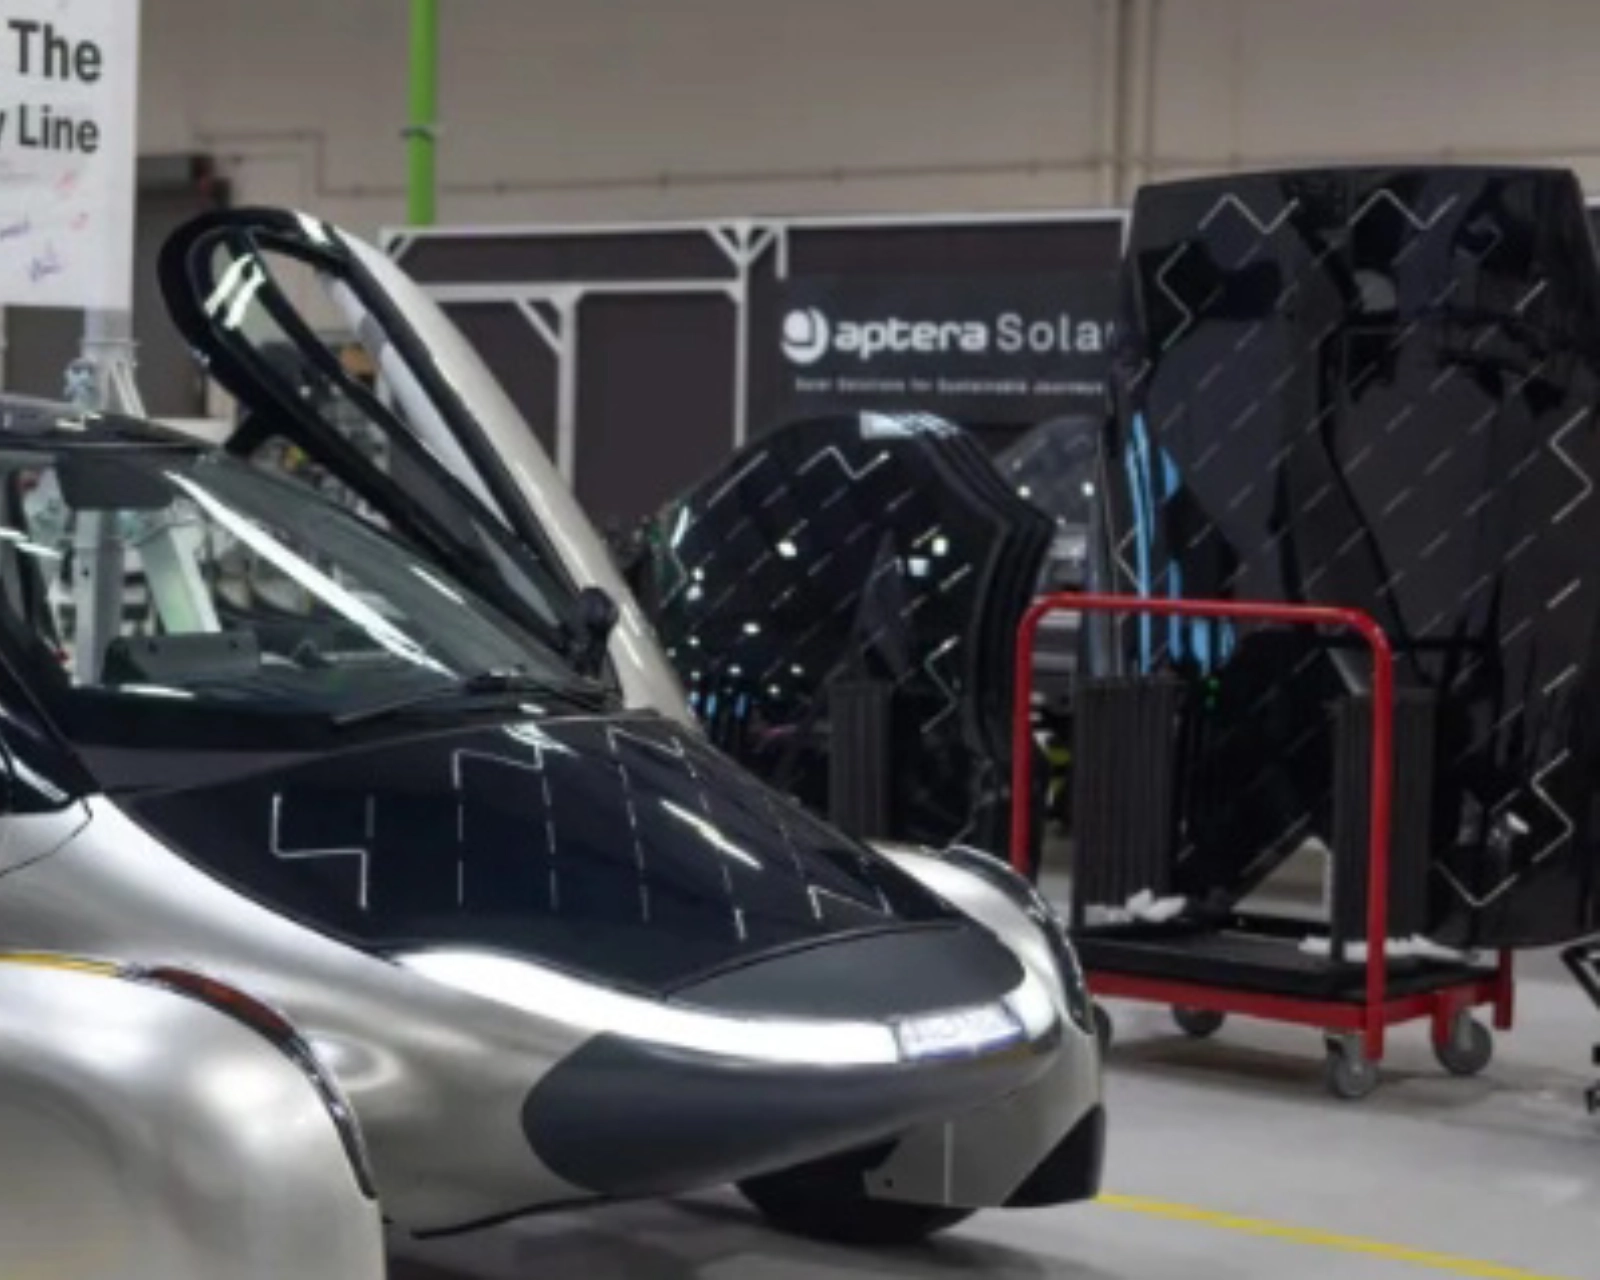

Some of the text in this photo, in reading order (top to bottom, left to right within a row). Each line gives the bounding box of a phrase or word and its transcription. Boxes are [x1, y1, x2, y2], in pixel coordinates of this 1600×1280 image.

[8, 19, 101, 82] The
[19, 103, 100, 153] Line
[834, 317, 988, 359] aptera
